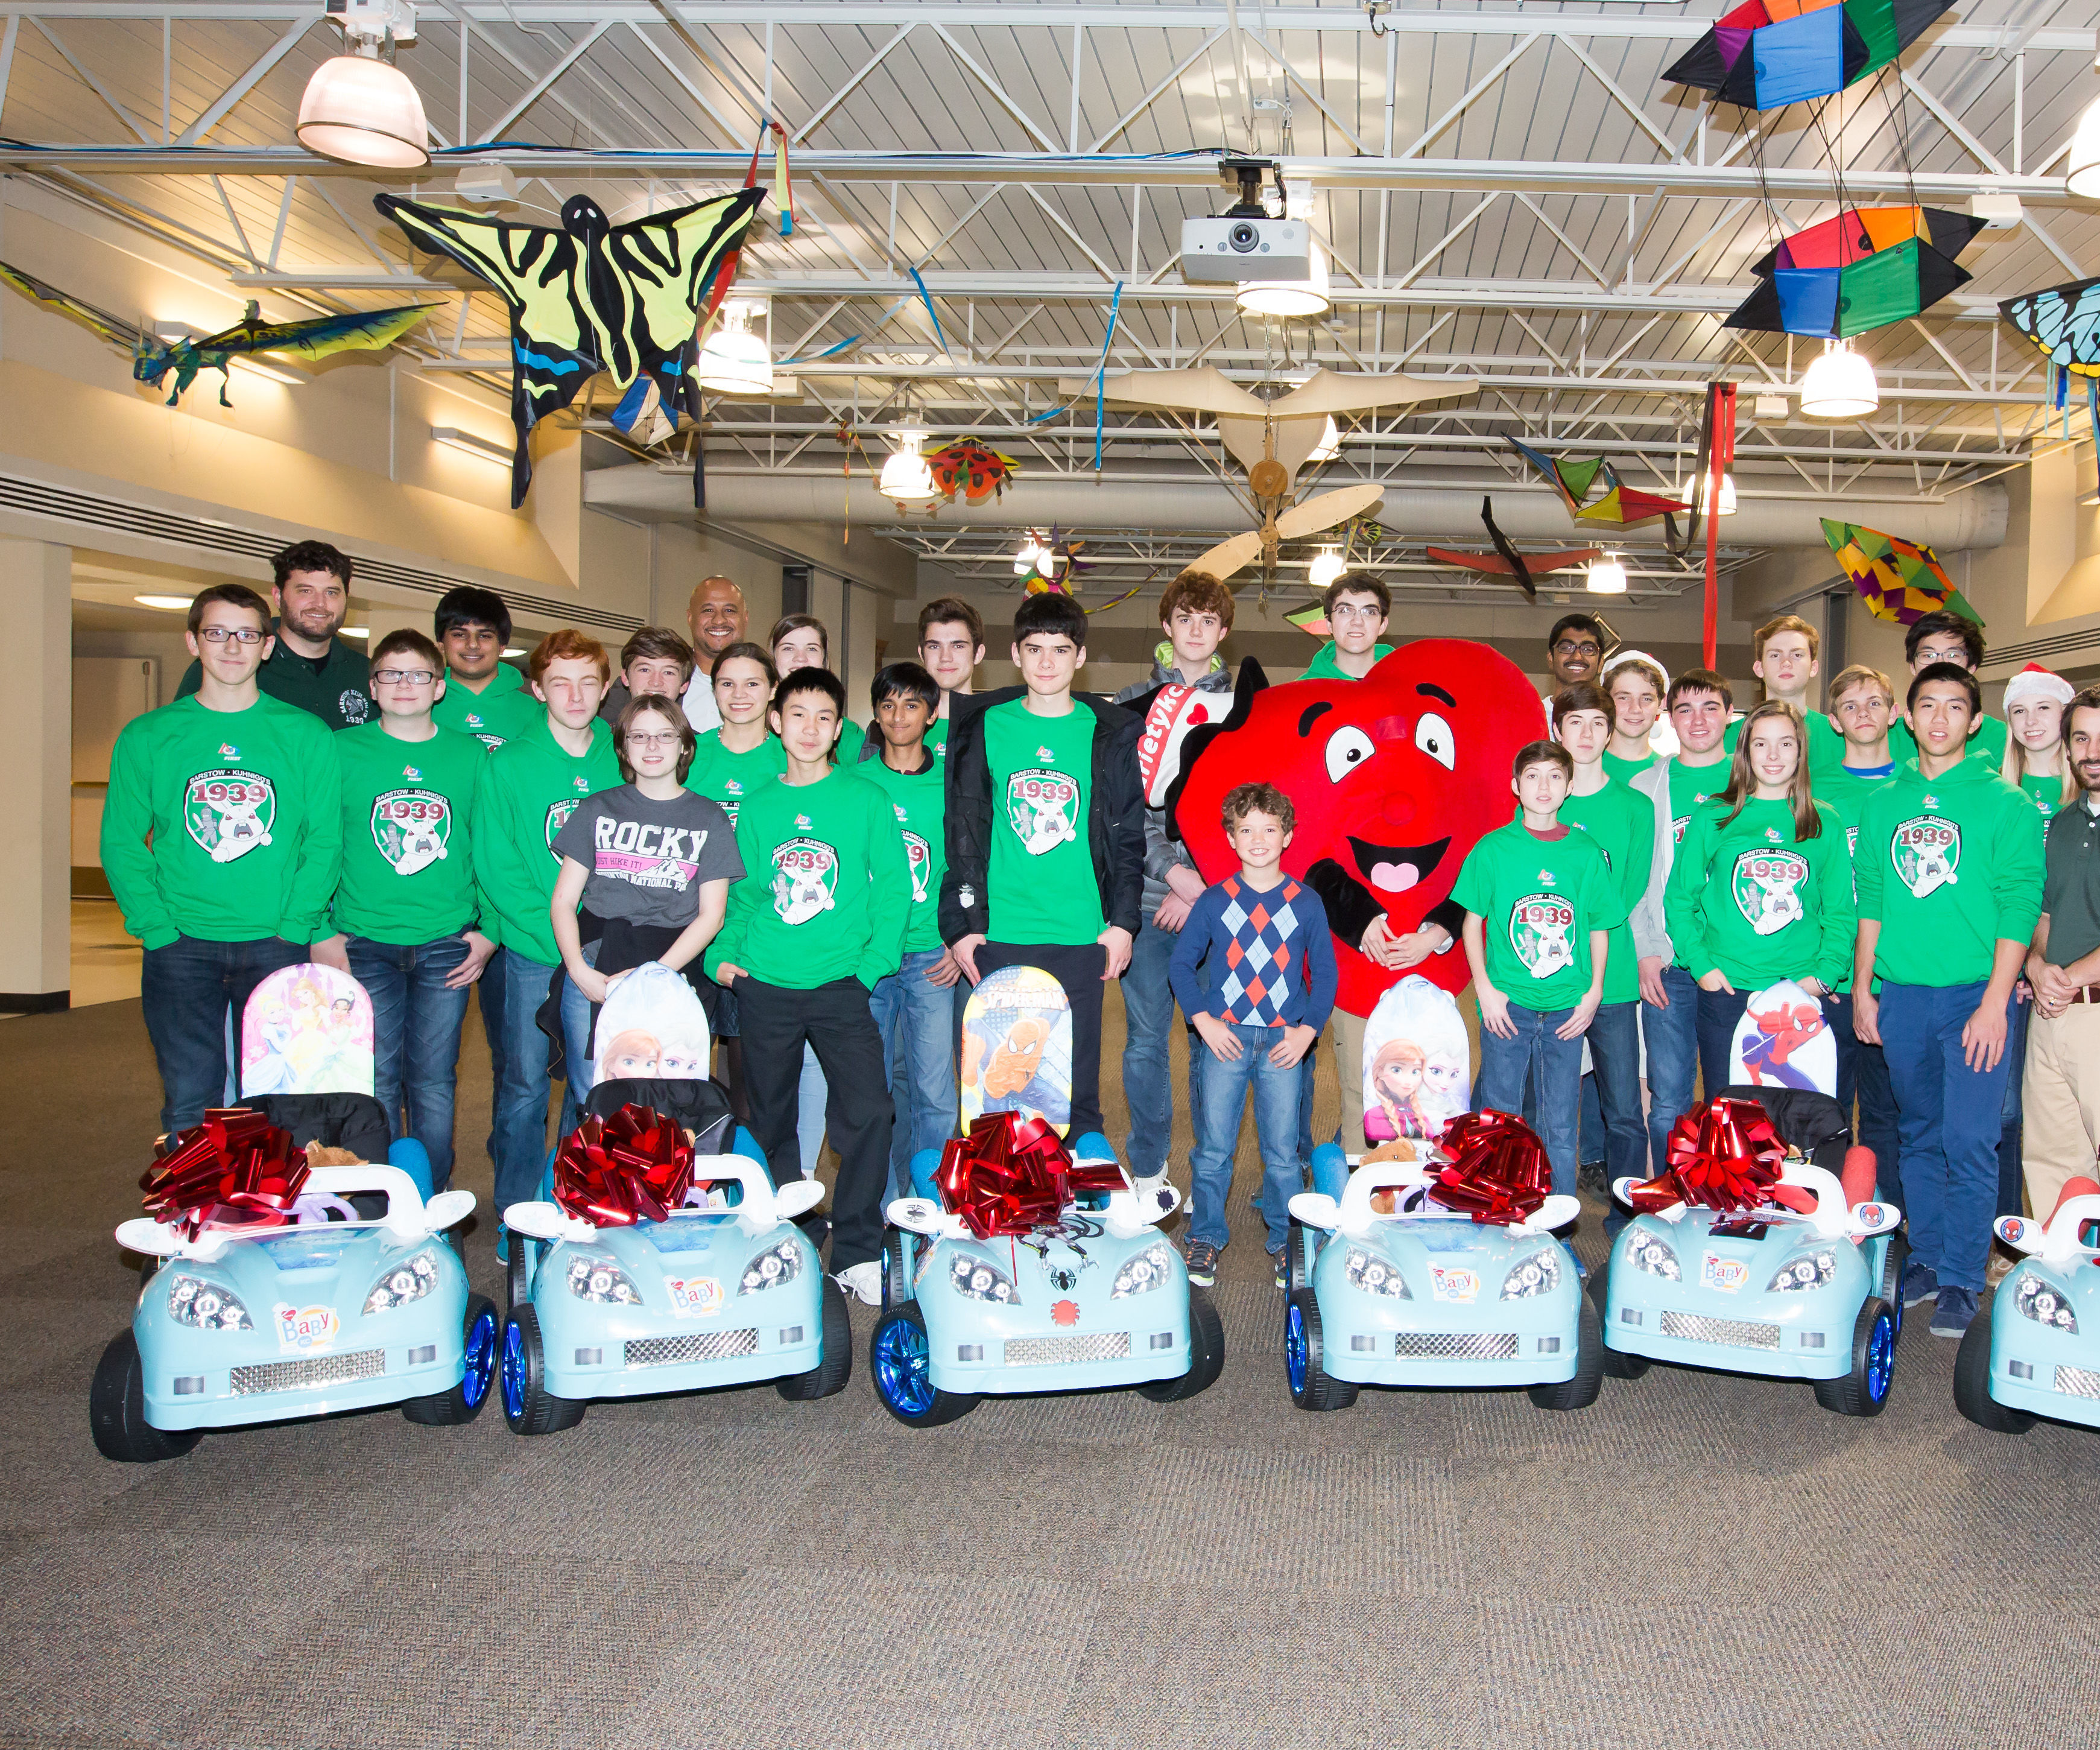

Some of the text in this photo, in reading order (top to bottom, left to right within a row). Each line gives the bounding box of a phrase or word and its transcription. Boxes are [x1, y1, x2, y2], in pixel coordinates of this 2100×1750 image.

[346, 715, 364, 724] 1939
[190, 770, 271, 785] BARSTOW KUHNIGITS
[1010, 769, 1077, 785] BARSTOW KUHNIGITS
[192, 782, 268, 803] 1939
[376, 789, 448, 804] BARSTOW KUHNIGITS
[1013, 780, 1074, 801] 1939
[379, 800, 445, 820] 1939
[1898, 815, 1959, 830] BARSTOW KUHNIGITS
[595, 816, 709, 862] ROCKY
[1900, 826, 1955, 846] 1939
[773, 838, 835, 854] BARSTOW KUHNIGITS
[610, 858, 628, 866] HIKE
[630, 861, 642, 870] IT!
[777, 850, 832, 870] 1939
[1739, 849, 1807, 864] BARSTOW KUHNIGITS
[1742, 860, 1804, 880] 1939
[630, 875, 672, 889] NATIONAL
[1515, 894, 1543, 907] BARSTOW
[1518, 905, 1572, 925] 1939
